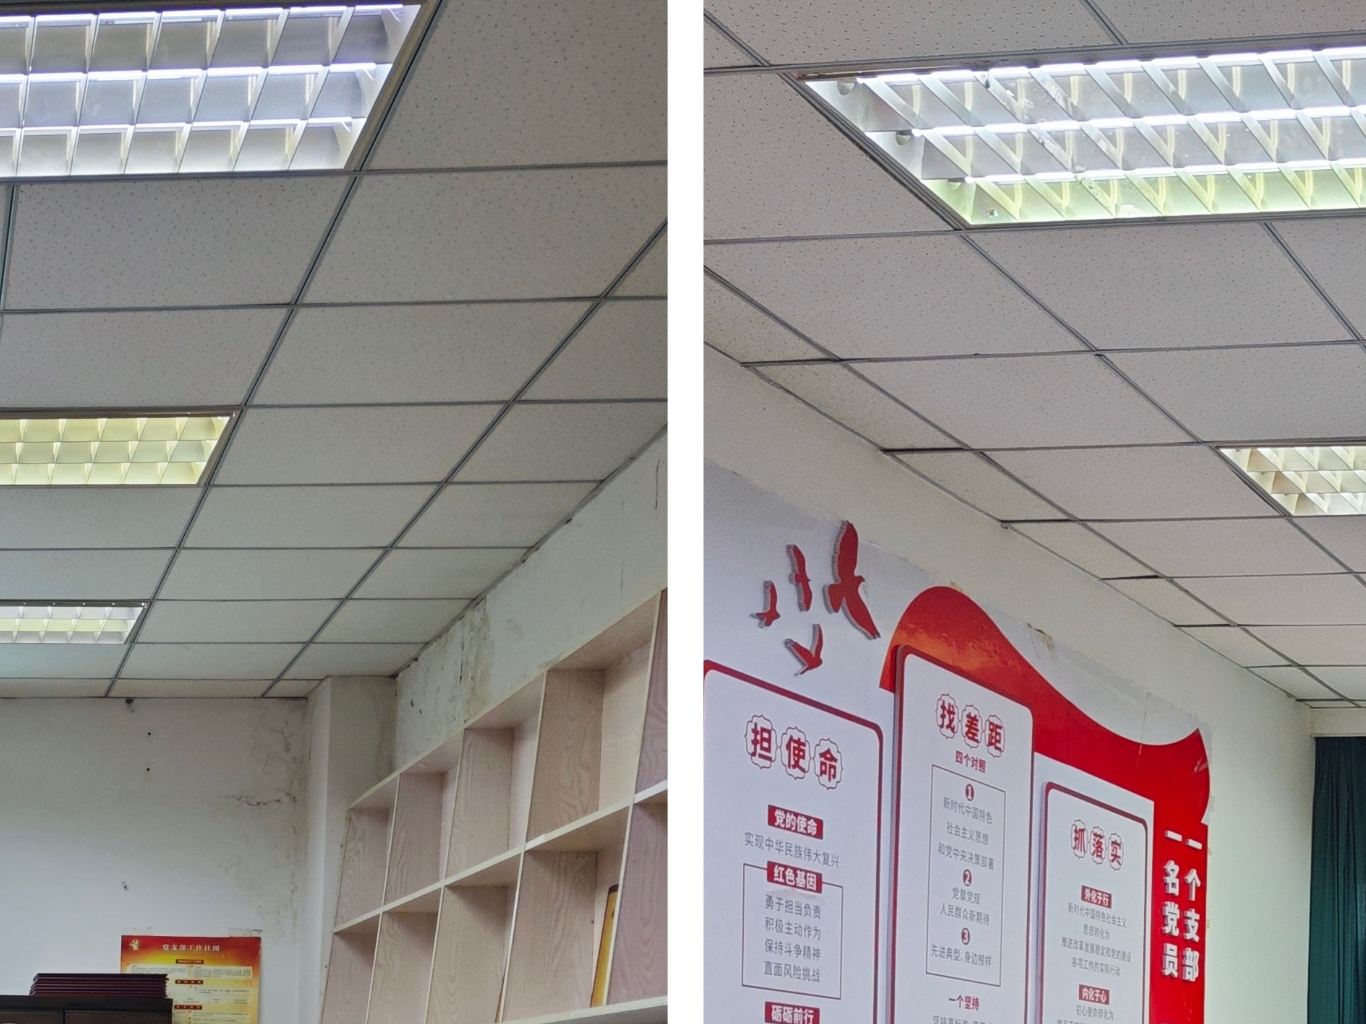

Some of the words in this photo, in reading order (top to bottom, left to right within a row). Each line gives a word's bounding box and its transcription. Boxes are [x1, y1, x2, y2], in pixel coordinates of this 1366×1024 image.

[939, 699, 1003, 753] 找差距
[750, 722, 838, 782] 担使命
[955, 750, 987, 774] 四个对照
[774, 809, 818, 836] 党的使命
[943, 796, 993, 825] 新时代中国特色
[946, 821, 989, 846] 社会主义思想
[1073, 825, 1122, 866] 抓落实
[744, 832, 840, 868] 实现中华民族伟大复兴
[938, 842, 995, 871] 和党中央决策部署
[773, 865, 817, 891] 红色基因
[765, 895, 821, 920] 勇于担当负责
[952, 887, 981, 905] 党章党规
[1084, 888, 1109, 907] 外化于行
[1161, 830, 1183, 978] 一名党员
[940, 903, 990, 926] 人民群众新期待
[1068, 902, 1127, 928] 新时代中国特色社会主义
[1181, 838, 1203, 982] 一个支部
[765, 916, 821, 940] 积极主动作为
[1083, 924, 1111, 941] 思想转化为
[764, 938, 821, 961] 保持斗争精神
[931, 944, 992, 968] 先进典型、身边榜样
[764, 960, 820, 983] 直面风险挑战
[1072, 956, 1121, 977] 各项工作的实际行动
[948, 994, 980, 1011] 一个坚持
[1082, 987, 1107, 1003] 内化于心
[1076, 1004, 1114, 1021] 初心使命转化为
